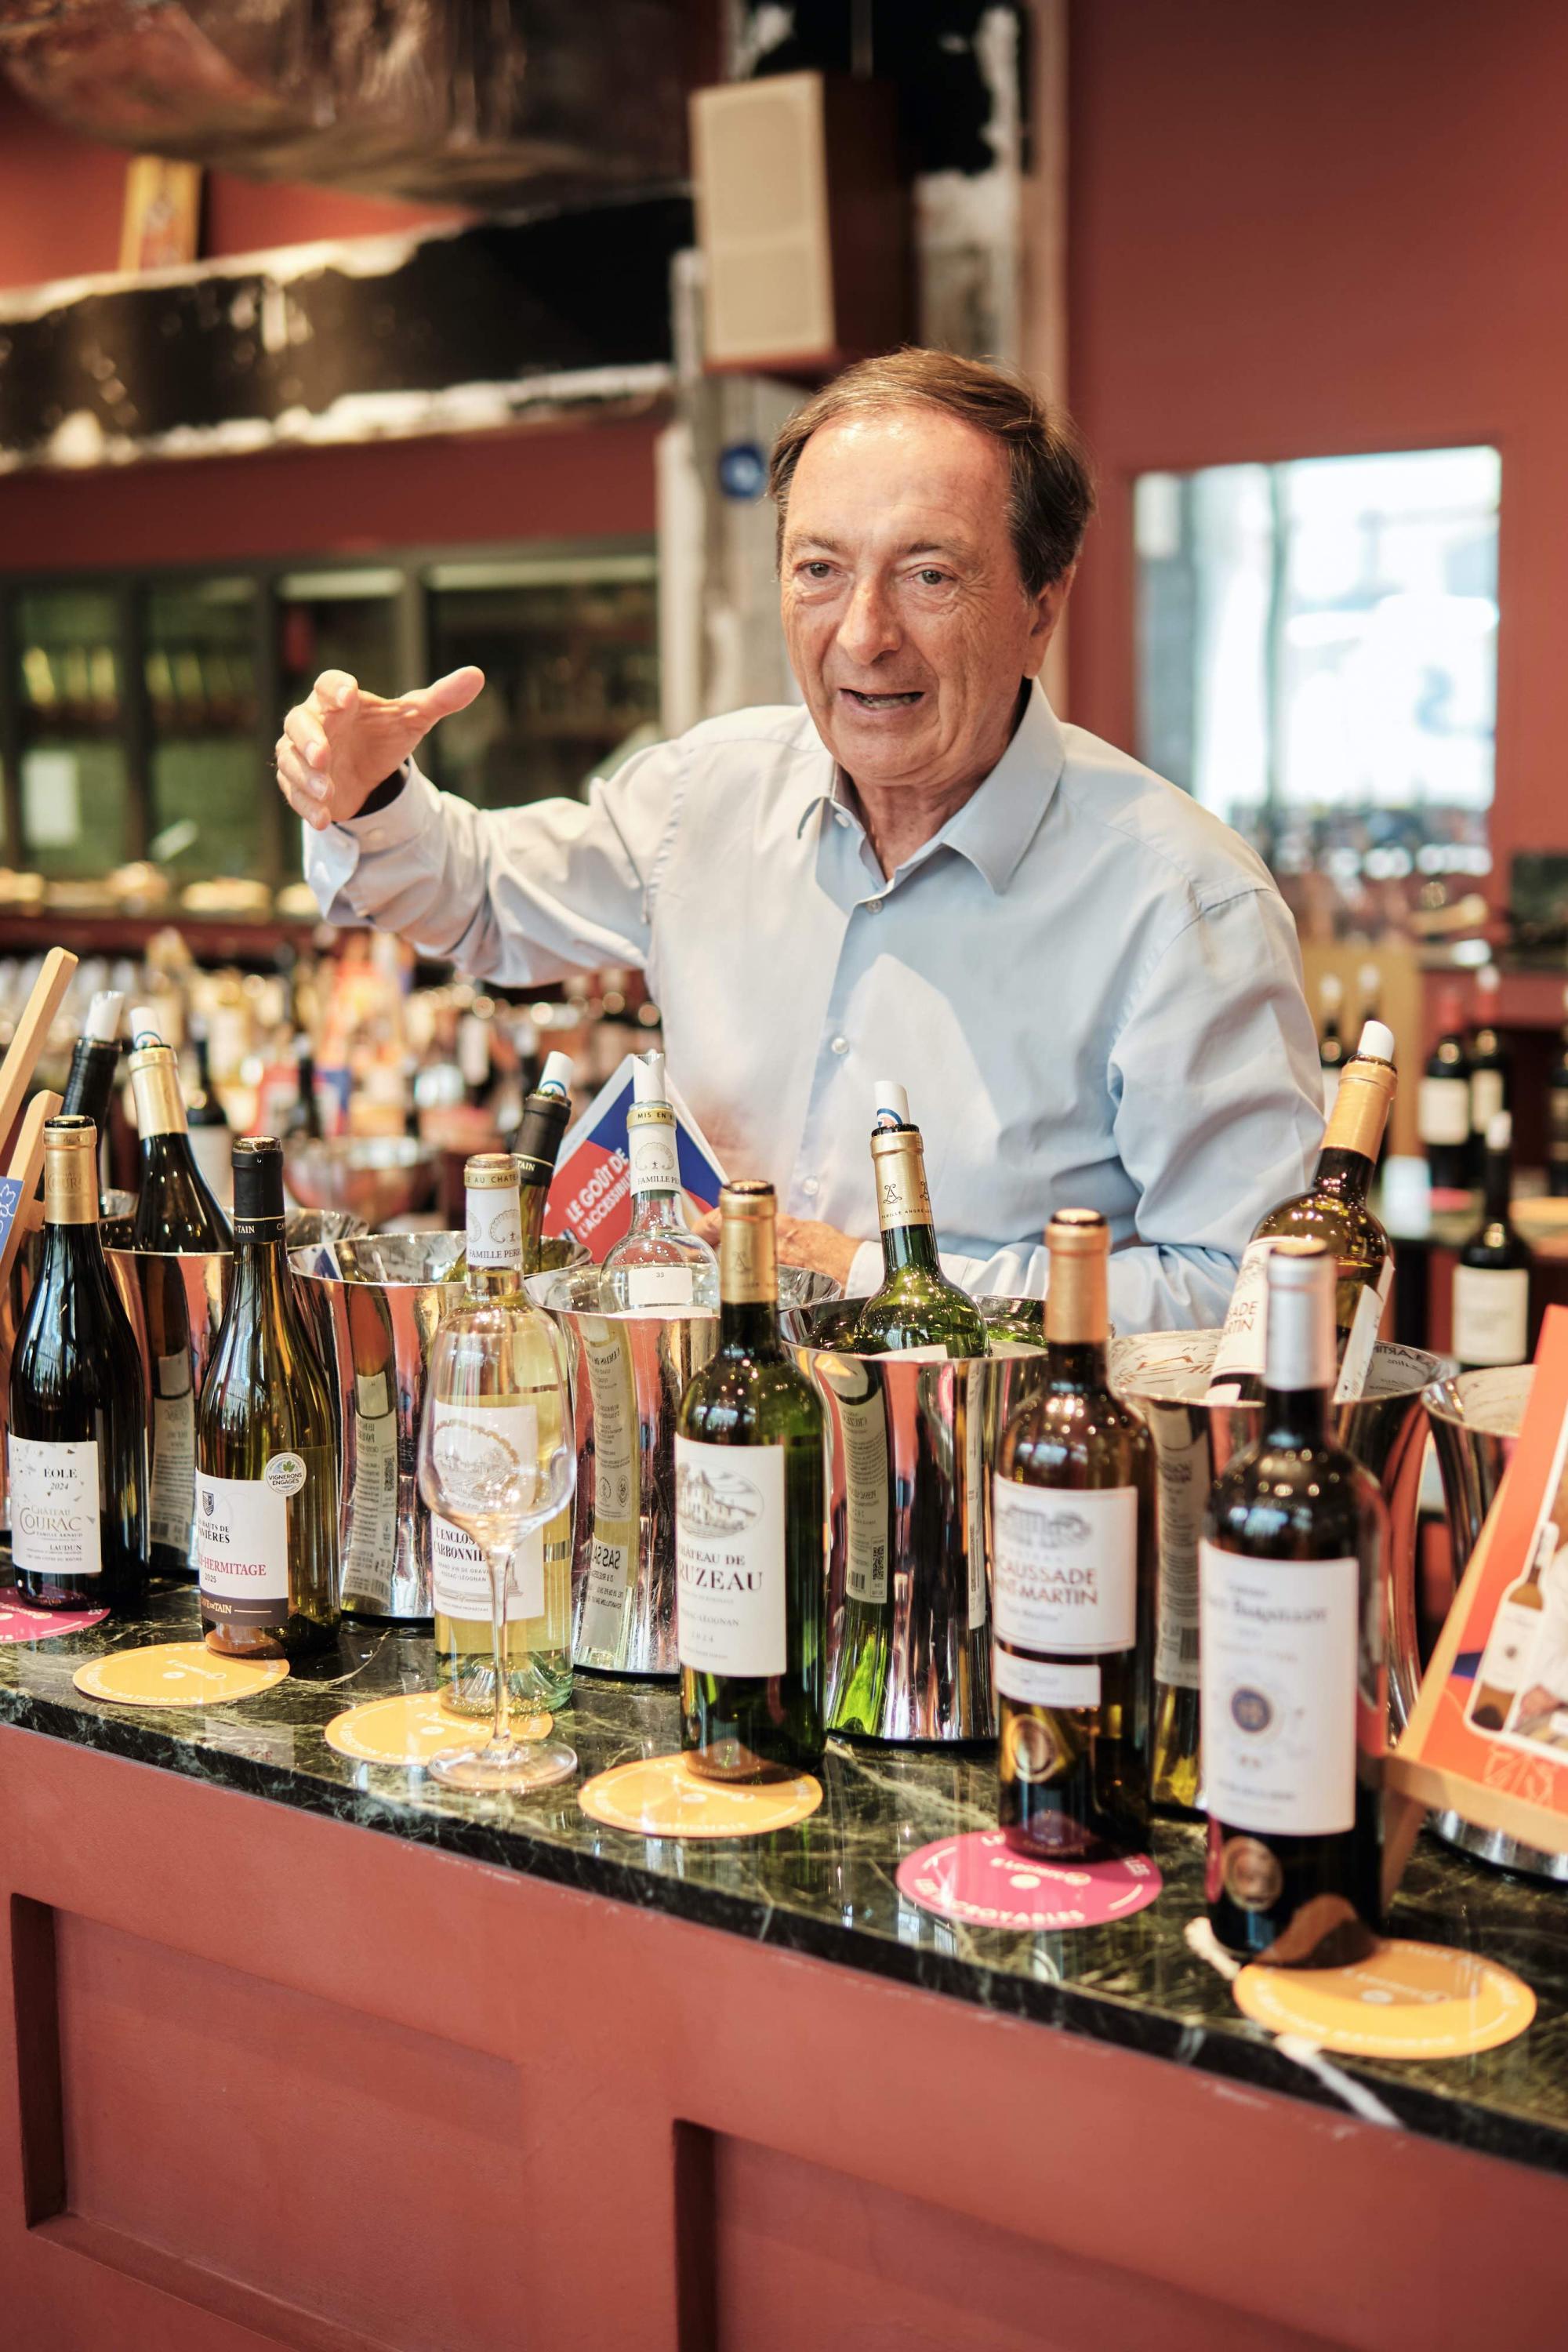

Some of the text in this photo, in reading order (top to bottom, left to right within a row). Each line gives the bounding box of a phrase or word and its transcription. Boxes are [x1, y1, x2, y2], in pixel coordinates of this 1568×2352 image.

[491, 1174, 517, 1183] CHATE
[637, 1175, 670, 1185] FAMILLE
[564, 1147, 630, 1224] LE GOÛT DE
[238, 1225, 255, 1234] TAIN
[469, 1247, 521, 1259] FAMILLE PERR
[50, 1482, 69, 1490] 2024
[20, 1507, 82, 1535] COURAC
[725, 1555, 746, 1566] DE
[205, 1572, 217, 1583] 2025
[679, 1559, 763, 1592] RUZEAU
[214, 1602, 232, 1614] TAIN
